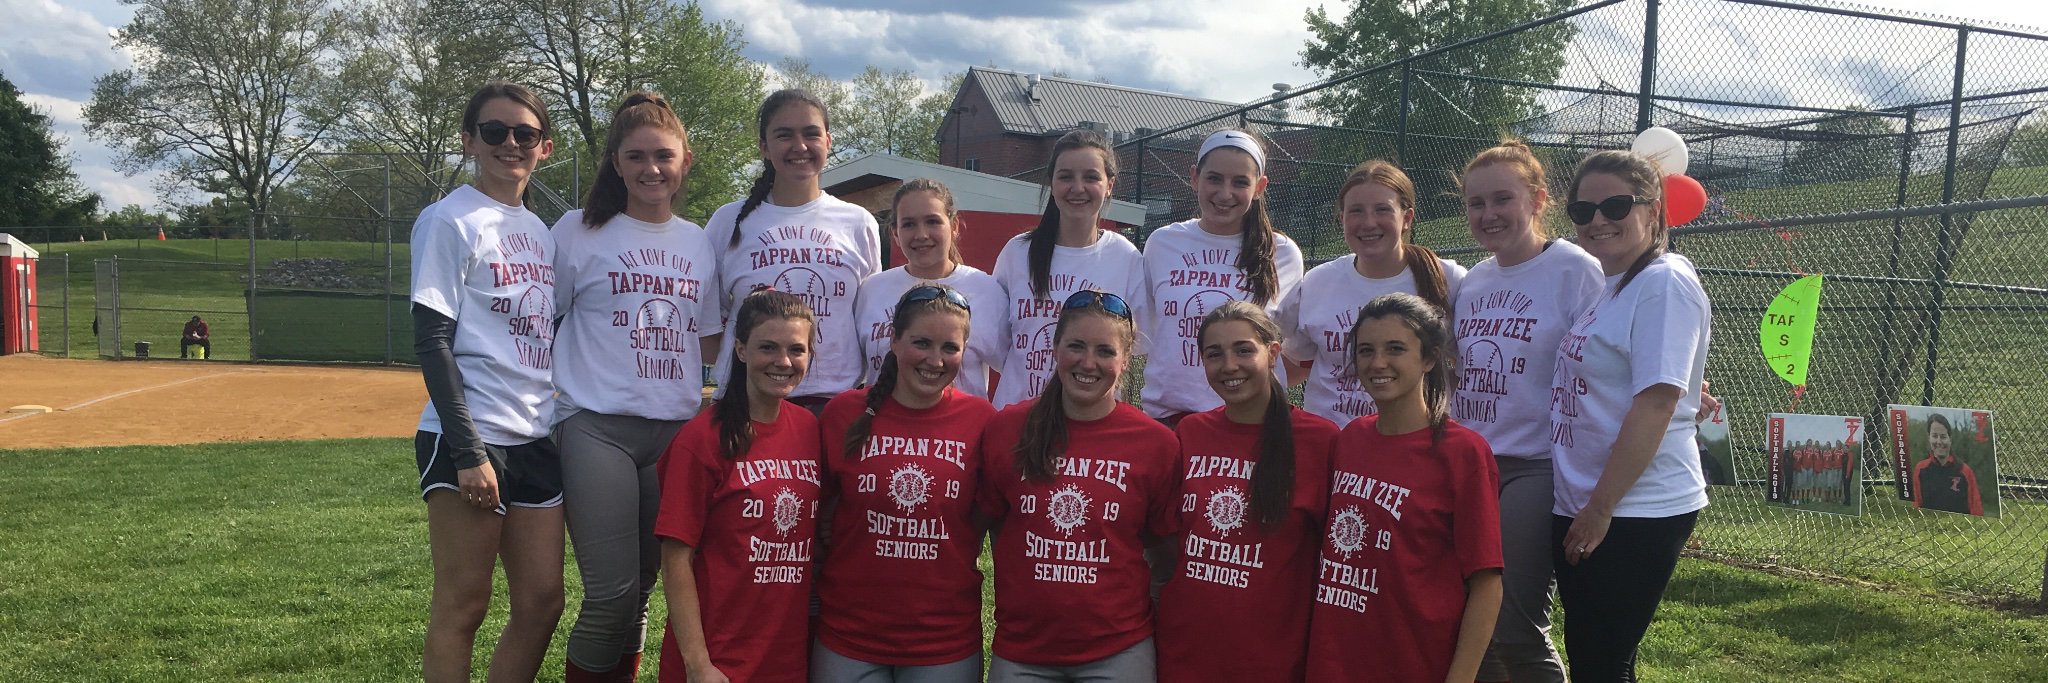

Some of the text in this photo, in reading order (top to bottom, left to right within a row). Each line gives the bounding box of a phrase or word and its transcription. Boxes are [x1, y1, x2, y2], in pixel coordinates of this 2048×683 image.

[758, 225, 833, 247] WE LOVE OUR
[618, 248, 692, 276] WE LOVE OUR
[750, 247, 843, 271] TAPPAN ZEE
[1182, 252, 1199, 268] WE
[1202, 249, 1230, 265] LOVE
[489, 262, 541, 288] TAPPAN
[1049, 273, 1076, 292] LOVE
[1170, 270, 1231, 288] TAPPAN
[608, 271, 700, 303] TAPPAN ZEE
[833, 280, 846, 297] 19
[491, 297, 511, 314] 20
[1018, 298, 1062, 320] TAPPA
[1164, 300, 1177, 316] 20
[1487, 289, 1512, 310] LOVE
[1510, 292, 1533, 315] OUR
[612, 310, 629, 327] 20
[1336, 309, 1353, 330] WE
[630, 326, 685, 353] SOFTBALL
[1016, 333, 1028, 349] 20
[1457, 317, 1538, 343] TAPPAN ZEE
[636, 351, 684, 380] SENIORS
[1510, 357, 1526, 374] 19
[1786, 364, 1794, 374] 2
[1572, 377, 1588, 396] 19
[1455, 391, 1500, 423] SENIORS
[861, 436, 966, 470] TAPPAN ZEE
[1895, 413, 1909, 498] SOFTBALL 2019
[736, 459, 821, 488] TAPPAN ZEE
[1095, 459, 1130, 492] ZEE
[1186, 455, 1256, 480] TAPPAN
[858, 474, 876, 493] 20
[945, 479, 960, 499] 19
[743, 499, 763, 518] 20
[1020, 494, 1036, 514] 20
[1103, 501, 1119, 521] 19
[1182, 493, 1197, 513] 20
[1374, 482, 1411, 522] ZEE
[867, 509, 949, 540] SOFTBALL
[749, 536, 811, 562] SOFTBALL
[875, 540, 938, 560] SENIORS
[1026, 531, 1110, 563] SOFTBALL
[1185, 530, 1264, 569] OFTBALL
[1375, 528, 1392, 551] 19
[753, 566, 803, 583] SENIORS
[1034, 563, 1097, 584] SENIORS
[1186, 561, 1250, 588] SENIORS
[1320, 550, 1379, 595] FTBALL
[1316, 584, 1368, 614] ENIORS
